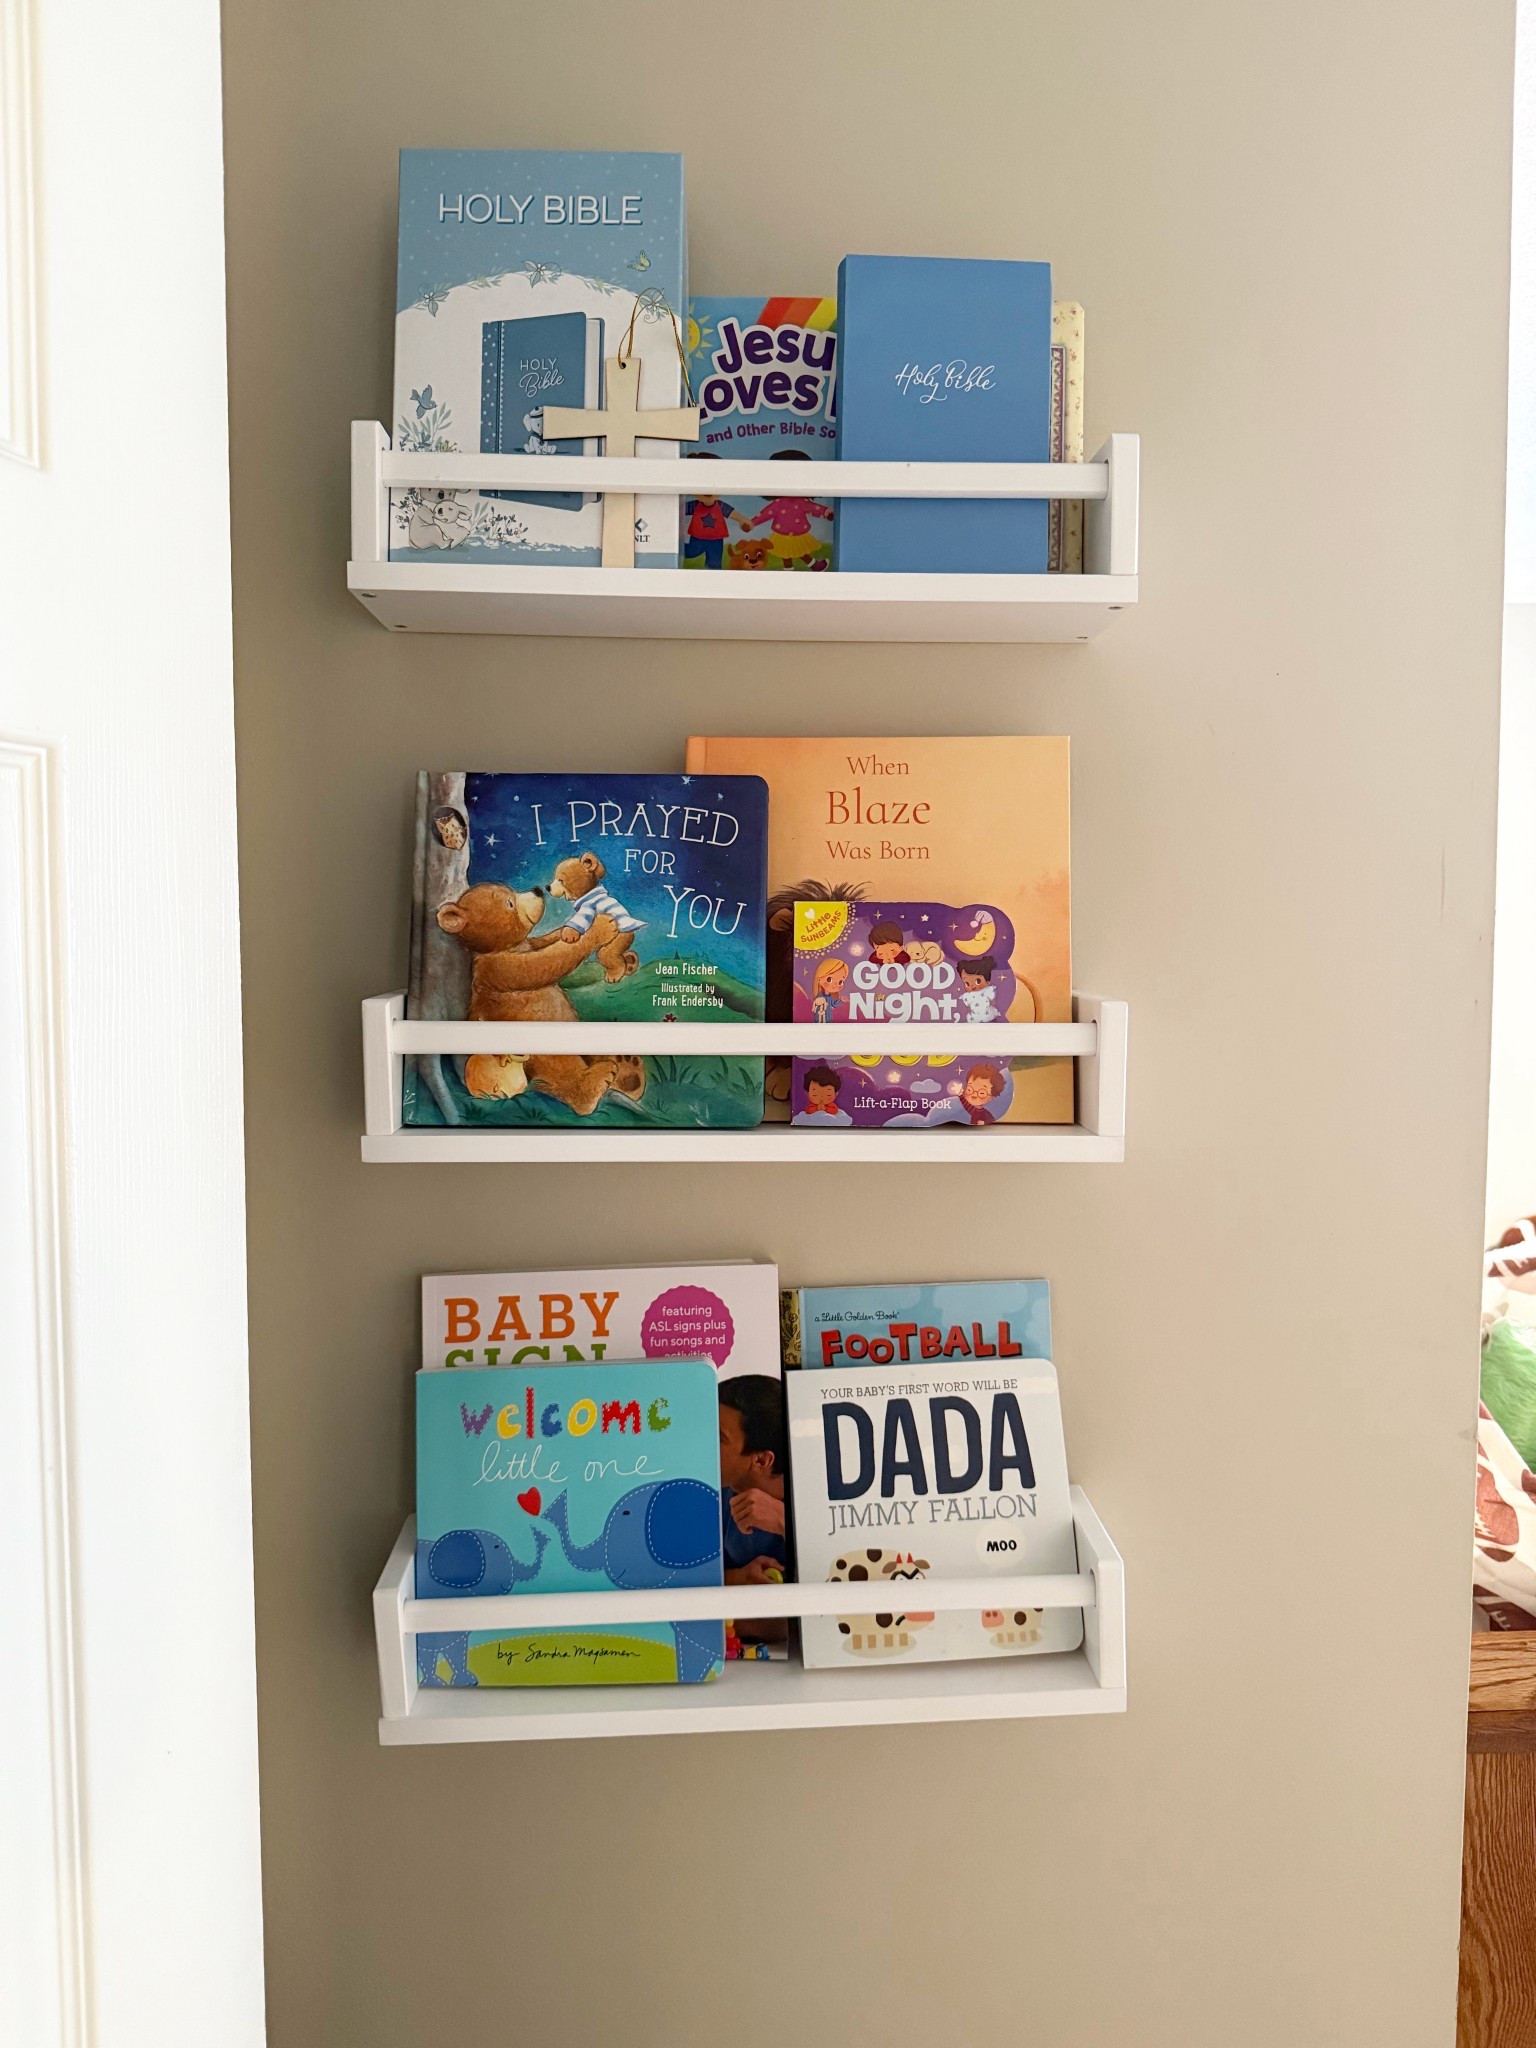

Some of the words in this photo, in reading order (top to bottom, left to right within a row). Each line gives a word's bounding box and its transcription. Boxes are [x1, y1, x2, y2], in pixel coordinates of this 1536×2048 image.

[438, 193, 534, 223] HOLY
[544, 195, 643, 225] BIBLE
[717, 322, 836, 373] Jesu
[519, 358, 558, 371] HOLY
[519, 367, 565, 397] Bible
[895, 363, 947, 403] Holy
[945, 360, 996, 392] Bible
[700, 371, 820, 419] oves
[706, 426, 733, 443] and
[737, 422, 776, 437] Other
[780, 422, 816, 436] Bible
[819, 425, 836, 439] So
[846, 754, 910, 776] When
[825, 787, 931, 825] Blaze
[531, 804, 547, 846] I
[567, 801, 739, 847] PRAYED
[624, 849, 676, 875] FOR
[825, 840, 871, 860] Was
[879, 840, 930, 860] Born
[663, 885, 747, 938] YOU
[655, 963, 679, 975] Jean
[682, 962, 718, 975] Fischer
[852, 961, 956, 990] GOOD
[652, 995, 678, 1007] Frank
[681, 995, 724, 1008] Endersby
[661, 983, 703, 993] Illustrated
[705, 983, 715, 994] by
[854, 1097, 918, 1111] Lift-a-Flap
[921, 1097, 952, 1110] Book
[444, 1291, 620, 1343] BABY
[662, 1305, 712, 1317] featuring
[821, 1312, 844, 1322] Little
[844, 1311, 875, 1322] Golden
[649, 1321, 672, 1332] ASL
[673, 1321, 702, 1333] signs
[703, 1319, 727, 1332] plus
[650, 1336, 668, 1347] fun
[670, 1337, 703, 1347] songs
[704, 1334, 726, 1345] and
[820, 1321, 1023, 1366] FOOTBALL
[820, 1388, 854, 1399] YOUR
[856, 1385, 896, 1397] BABY'S
[898, 1383, 930, 1395] FIRST
[932, 1381, 969, 1393] WORD
[972, 1380, 1001, 1391] WILL
[1003, 1379, 1018, 1389] BE
[460, 1386, 672, 1439] welcome
[822, 1392, 1036, 1500] DADA
[472, 1440, 569, 1487] little
[584, 1455, 665, 1483] one
[828, 1501, 919, 1536] JIMMY
[928, 1494, 1037, 1523] FALLON
[986, 1539, 1017, 1552] MOO
[497, 1643, 520, 1666] by
[525, 1642, 570, 1662] Sandra
